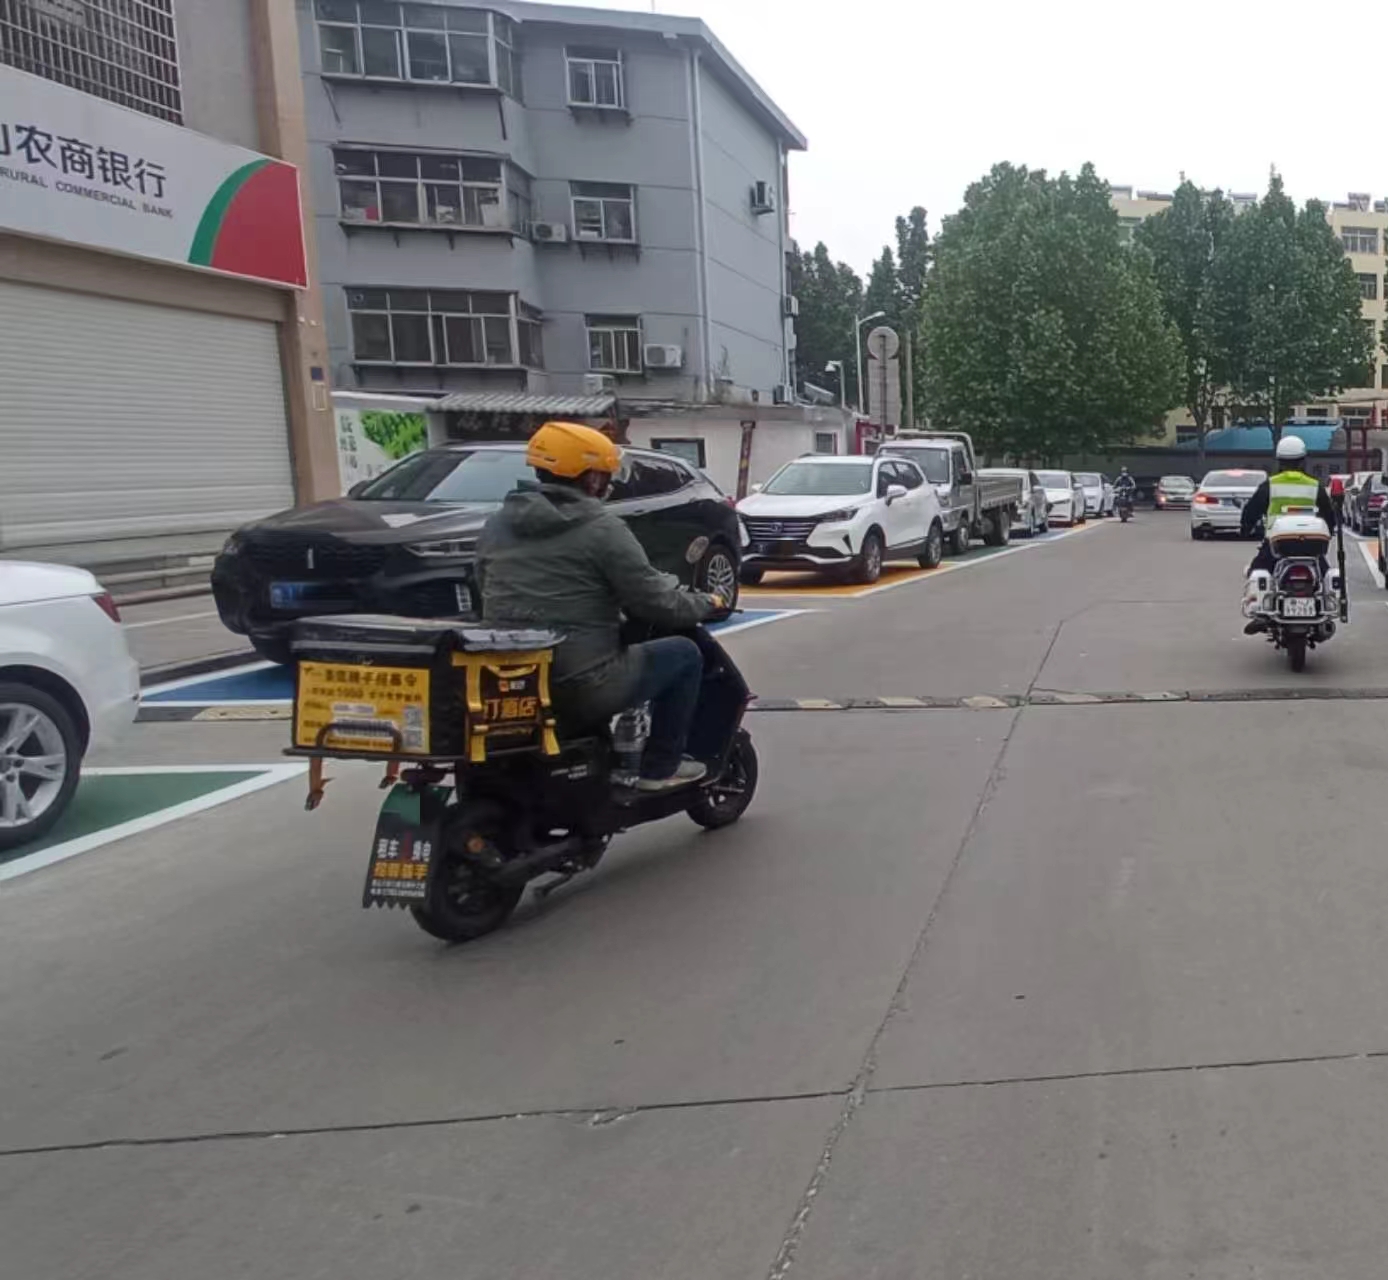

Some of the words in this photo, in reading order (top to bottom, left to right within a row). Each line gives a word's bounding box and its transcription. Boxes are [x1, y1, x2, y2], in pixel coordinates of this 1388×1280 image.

[0, 167, 48, 188] RURAL
[55, 181, 137, 210] COMMERCIAL
[142, 203, 174, 219] BANK
